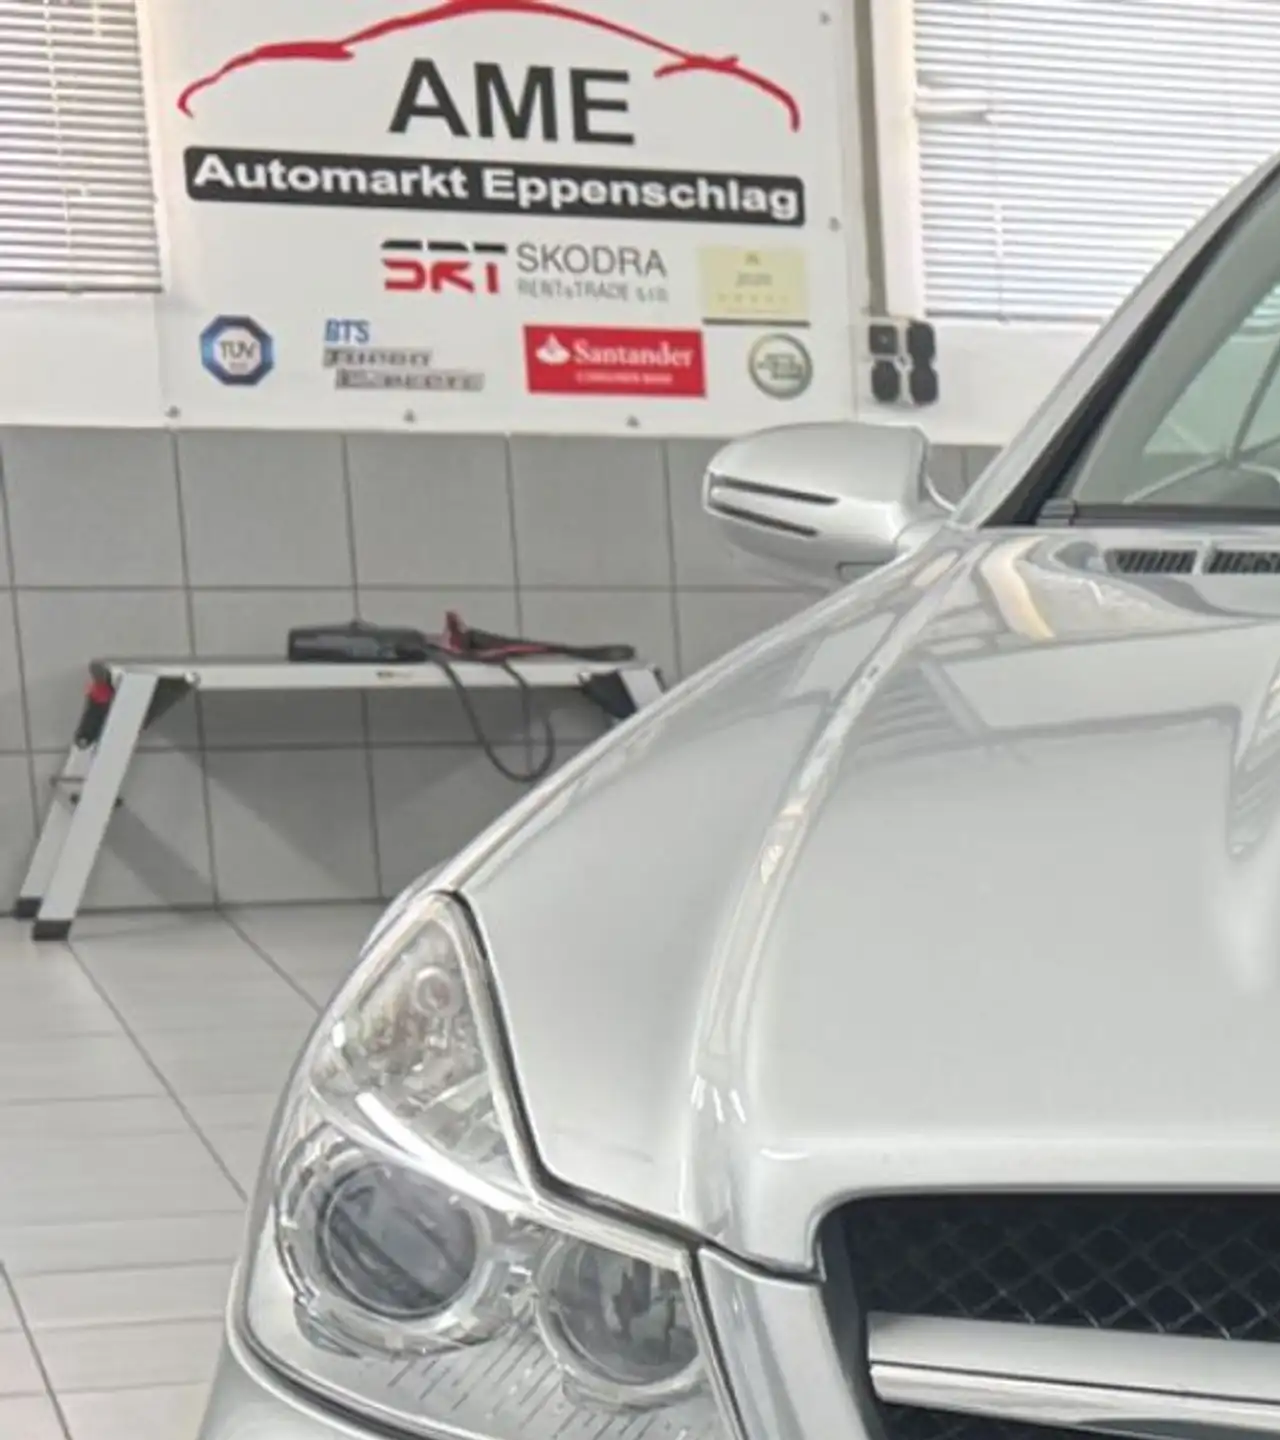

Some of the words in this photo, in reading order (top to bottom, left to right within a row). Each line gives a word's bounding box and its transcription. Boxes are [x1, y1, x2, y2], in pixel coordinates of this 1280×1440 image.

[388, 58, 636, 146] AME
[194, 154, 469, 199] Automarkt
[482, 169, 800, 221] Eppenschlag
[516, 242, 668, 277] SKODRA
[571, 337, 694, 367] Santander
